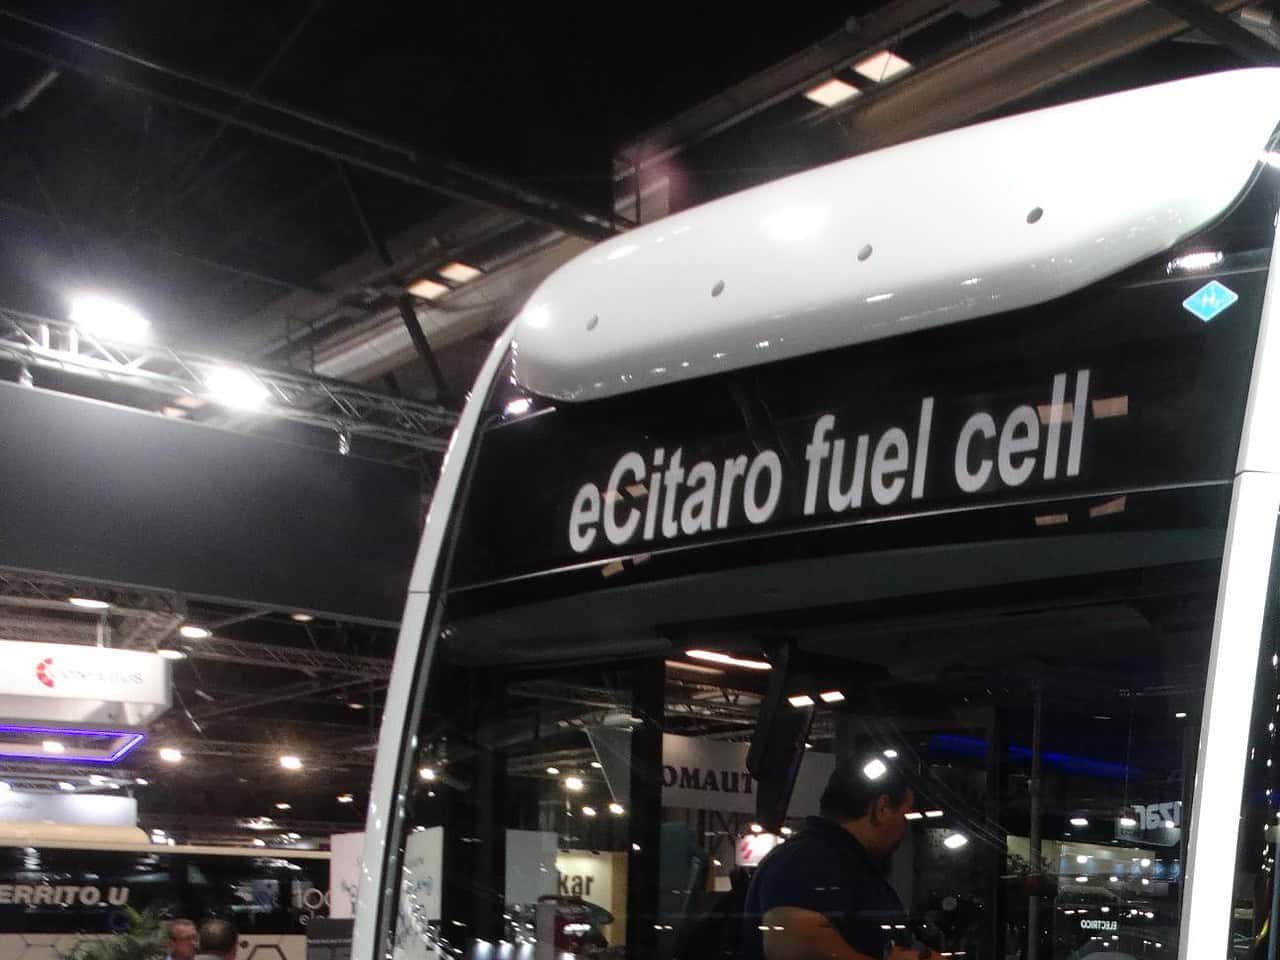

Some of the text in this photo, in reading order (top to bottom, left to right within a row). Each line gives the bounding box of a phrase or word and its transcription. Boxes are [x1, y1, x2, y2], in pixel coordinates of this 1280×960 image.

[568, 369, 1090, 553] eCitaro fuel cell
